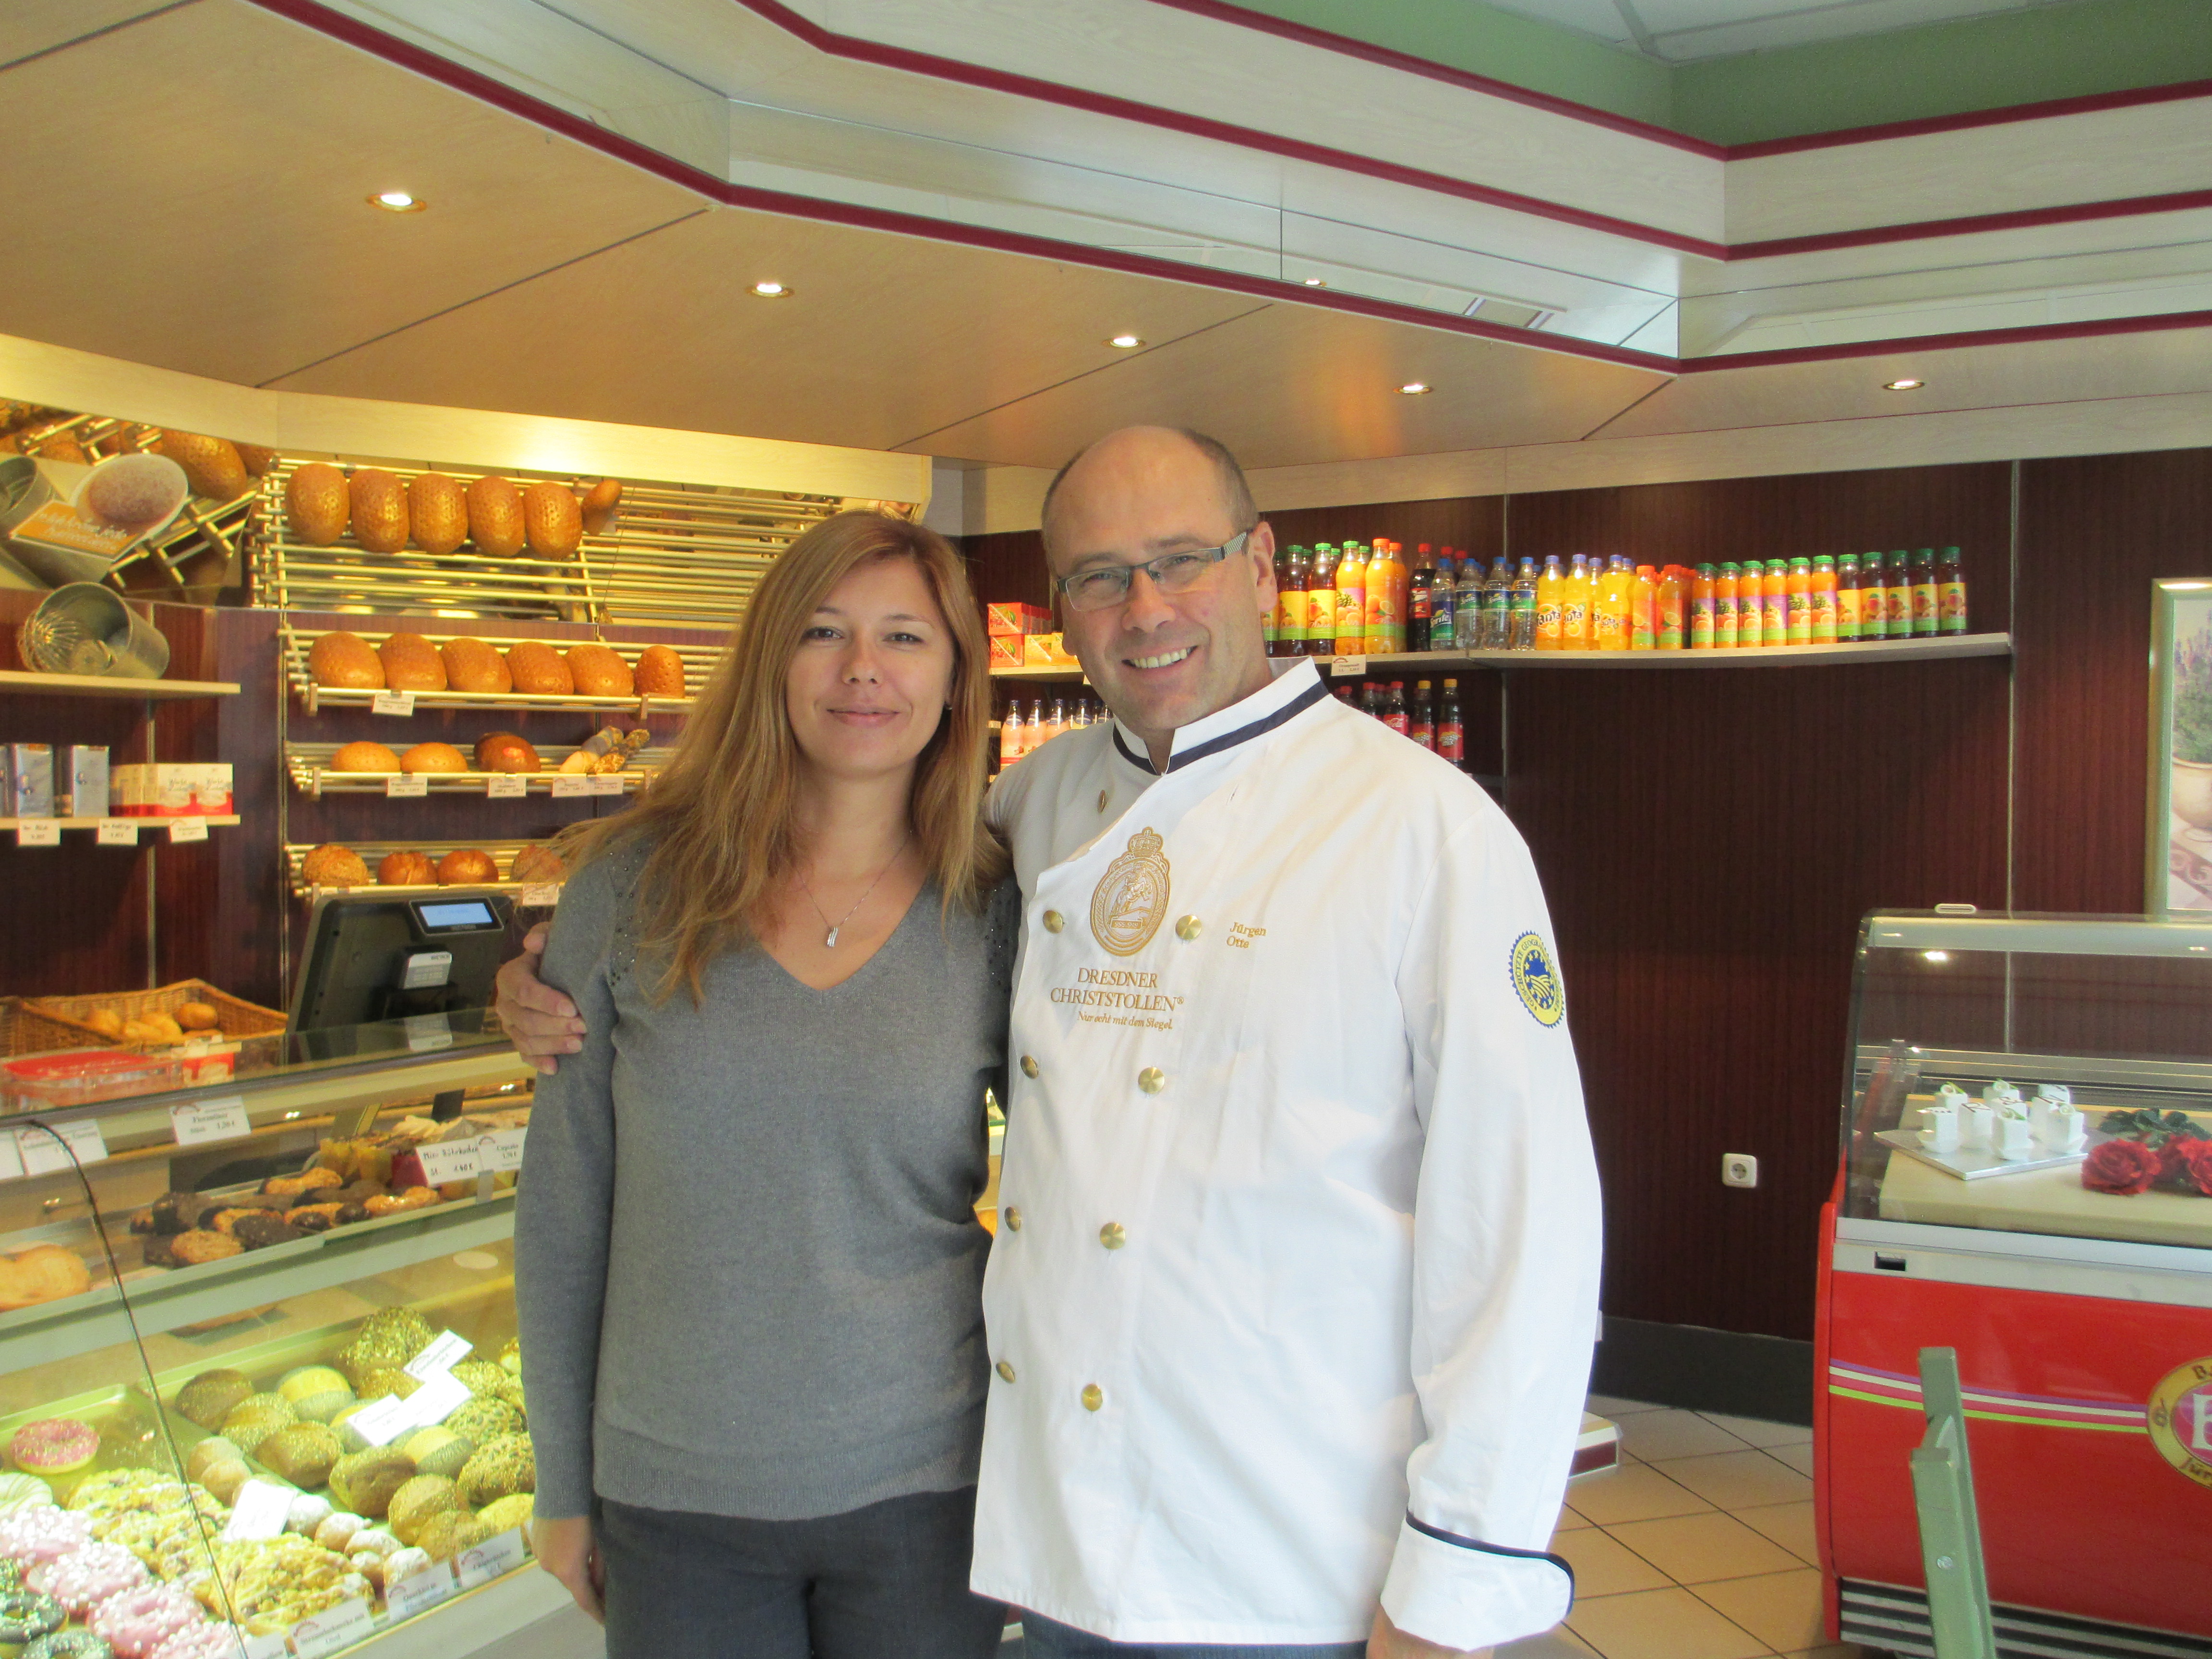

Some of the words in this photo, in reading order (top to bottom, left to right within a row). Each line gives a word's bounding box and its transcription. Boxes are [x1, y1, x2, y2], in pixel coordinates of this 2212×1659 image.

[1230, 922, 1267, 938] Jürgen
[1226, 936, 1249, 948] Otte
[1078, 967, 1159, 988] DRESDNER
[1078, 1011, 1094, 1022] Nur
[1094, 1013, 1111, 1023] echt
[1112, 1016, 1128, 1026] mit
[1129, 1016, 1144, 1027] dem
